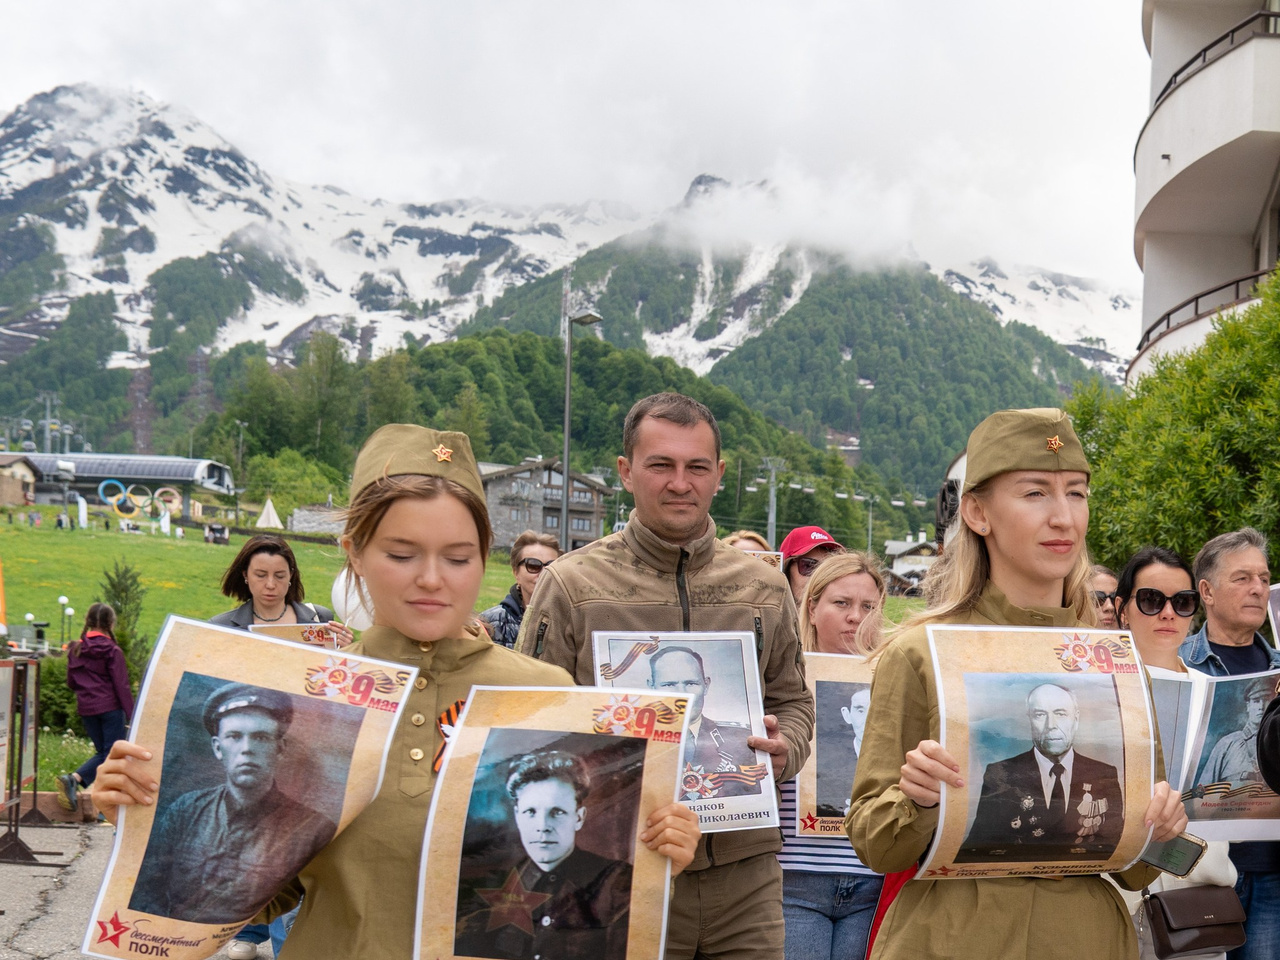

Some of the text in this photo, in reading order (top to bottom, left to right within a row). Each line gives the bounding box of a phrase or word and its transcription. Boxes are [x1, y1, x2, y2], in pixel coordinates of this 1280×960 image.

[1093, 644, 1139, 674] 9 мая
[347, 674, 400, 713] 9 мая
[634, 707, 682, 743] 9 мая
[688, 803, 725, 812] наков
[1032, 863, 1106, 871] Кузьминных
[129, 941, 170, 958] ПОЛК
